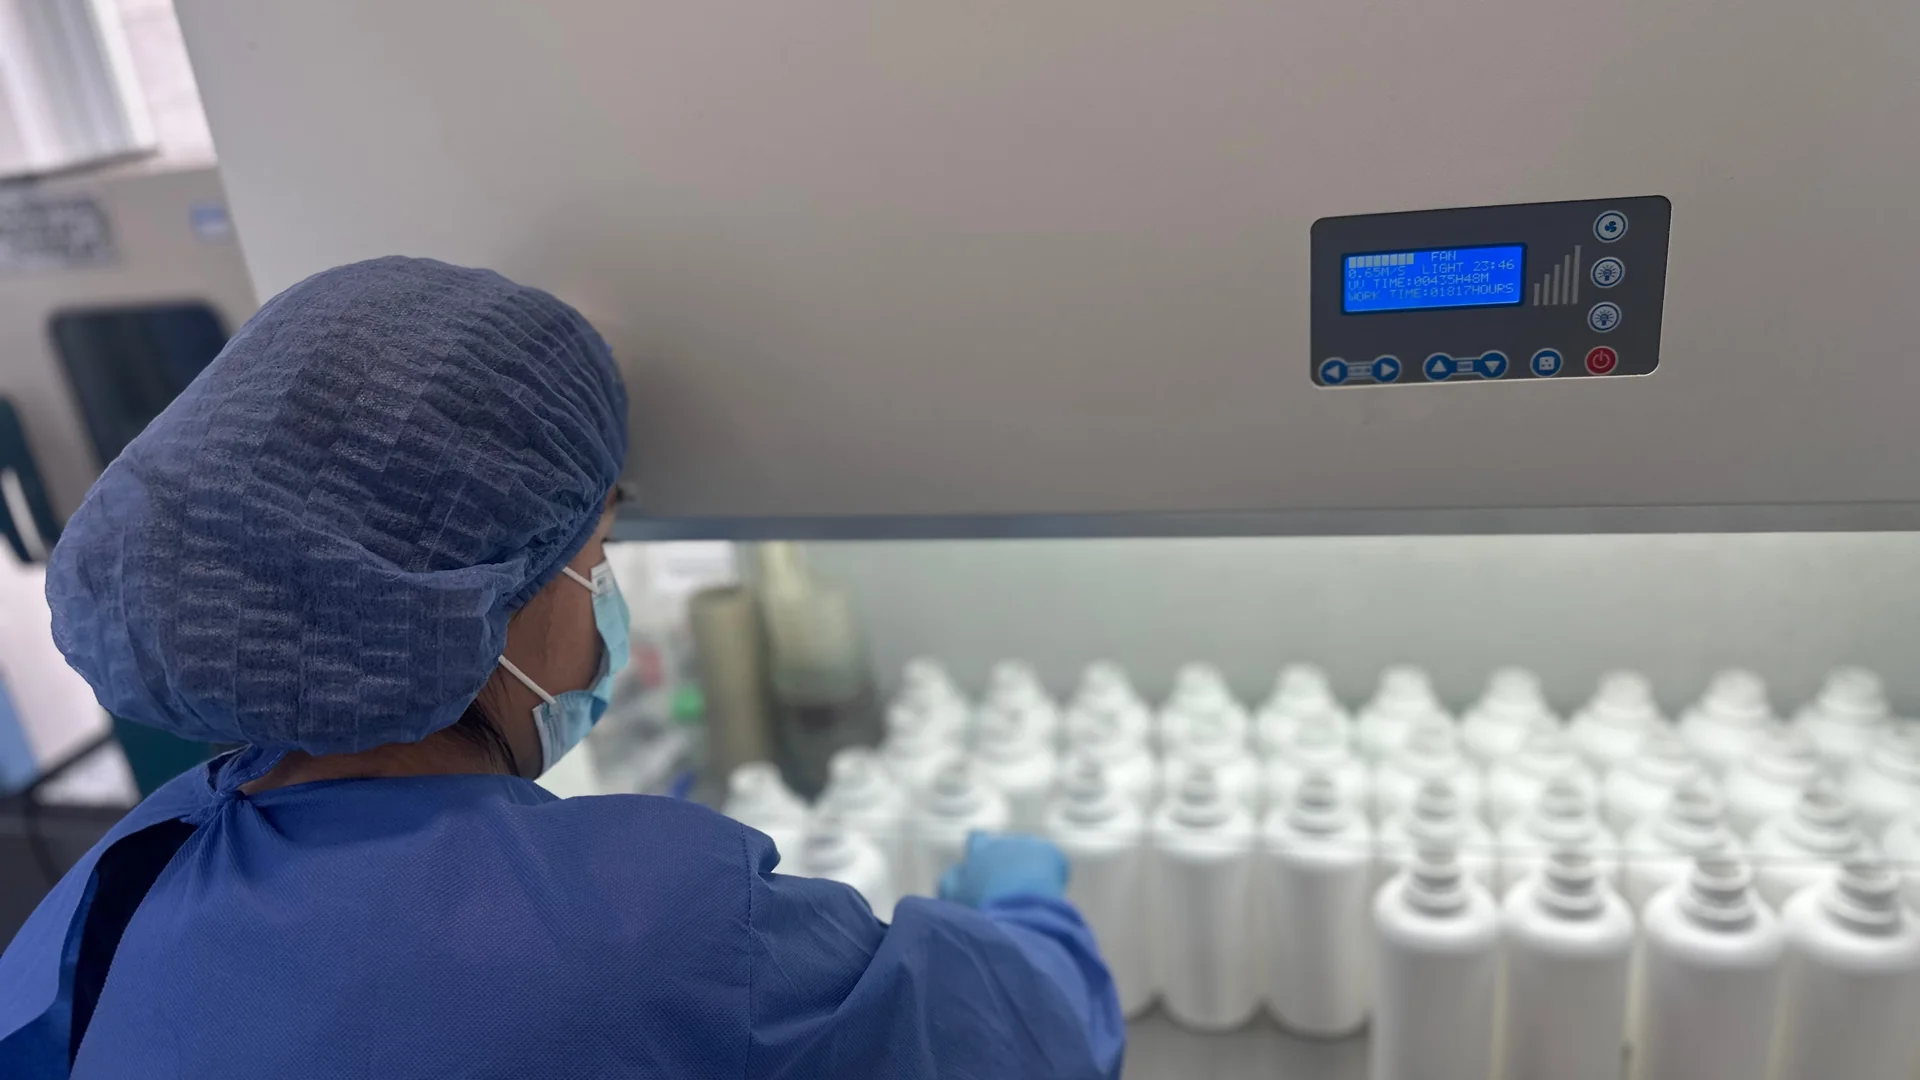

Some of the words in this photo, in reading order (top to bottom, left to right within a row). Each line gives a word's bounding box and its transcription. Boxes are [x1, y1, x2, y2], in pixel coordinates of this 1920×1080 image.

[1431, 250, 1456, 262] FAN
[1348, 265, 1406, 279] 0.65M/S
[1422, 262, 1464, 275] LIGHT
[1473, 260, 1515, 272] 23:46
[1348, 280, 1365, 290] UV
[1348, 291, 1381, 302] WORK
